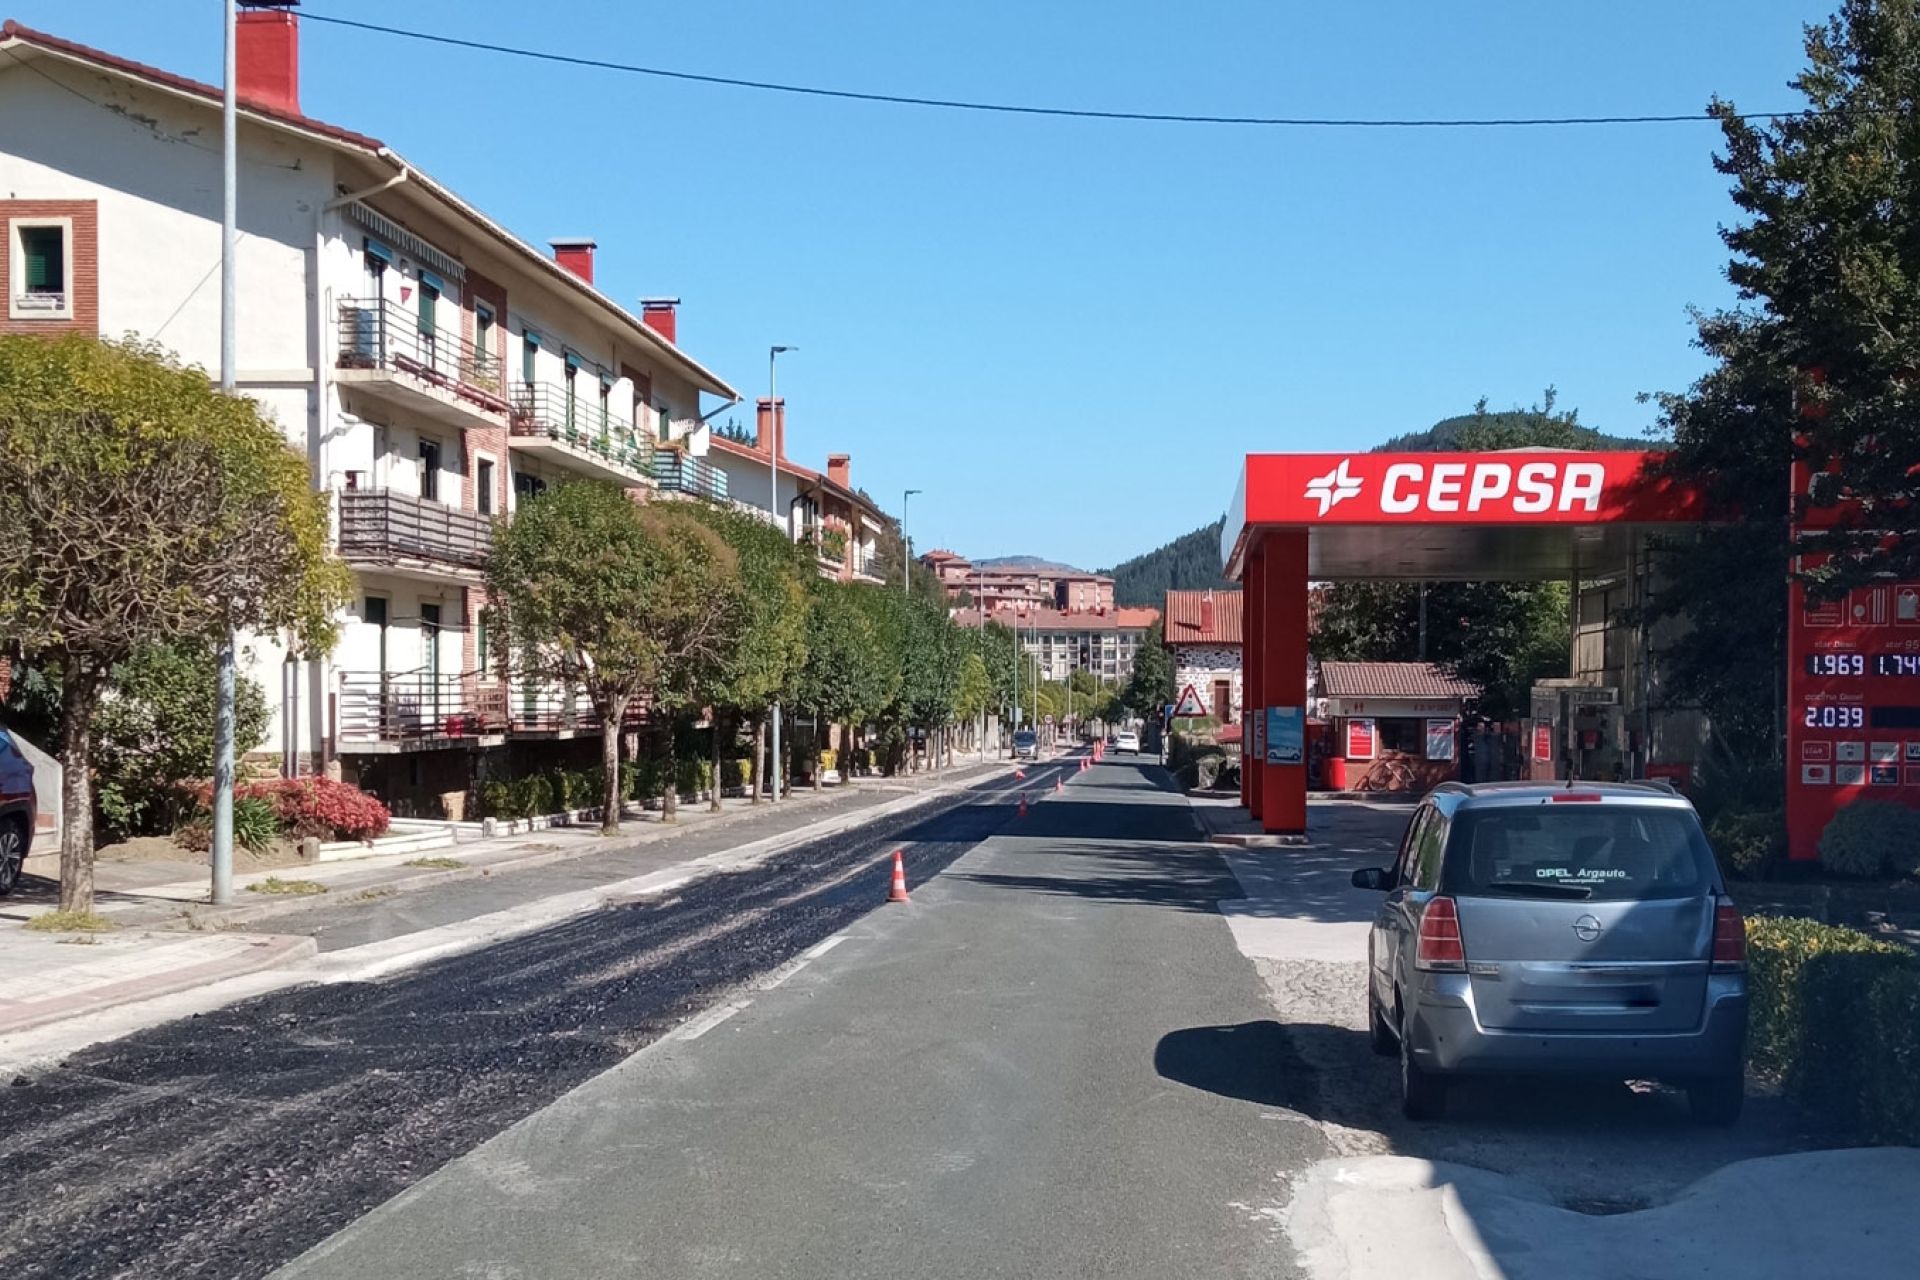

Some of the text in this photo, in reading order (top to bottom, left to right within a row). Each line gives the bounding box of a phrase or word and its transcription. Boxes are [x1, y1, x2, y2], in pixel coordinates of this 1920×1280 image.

[1380, 463, 1605, 513] CEPSA
[1814, 655, 1864, 675] 1.969
[1880, 655, 1920, 675] 1.74
[1805, 706, 1863, 728] 2.039
[1536, 868, 1626, 879] OPEL Argauto
